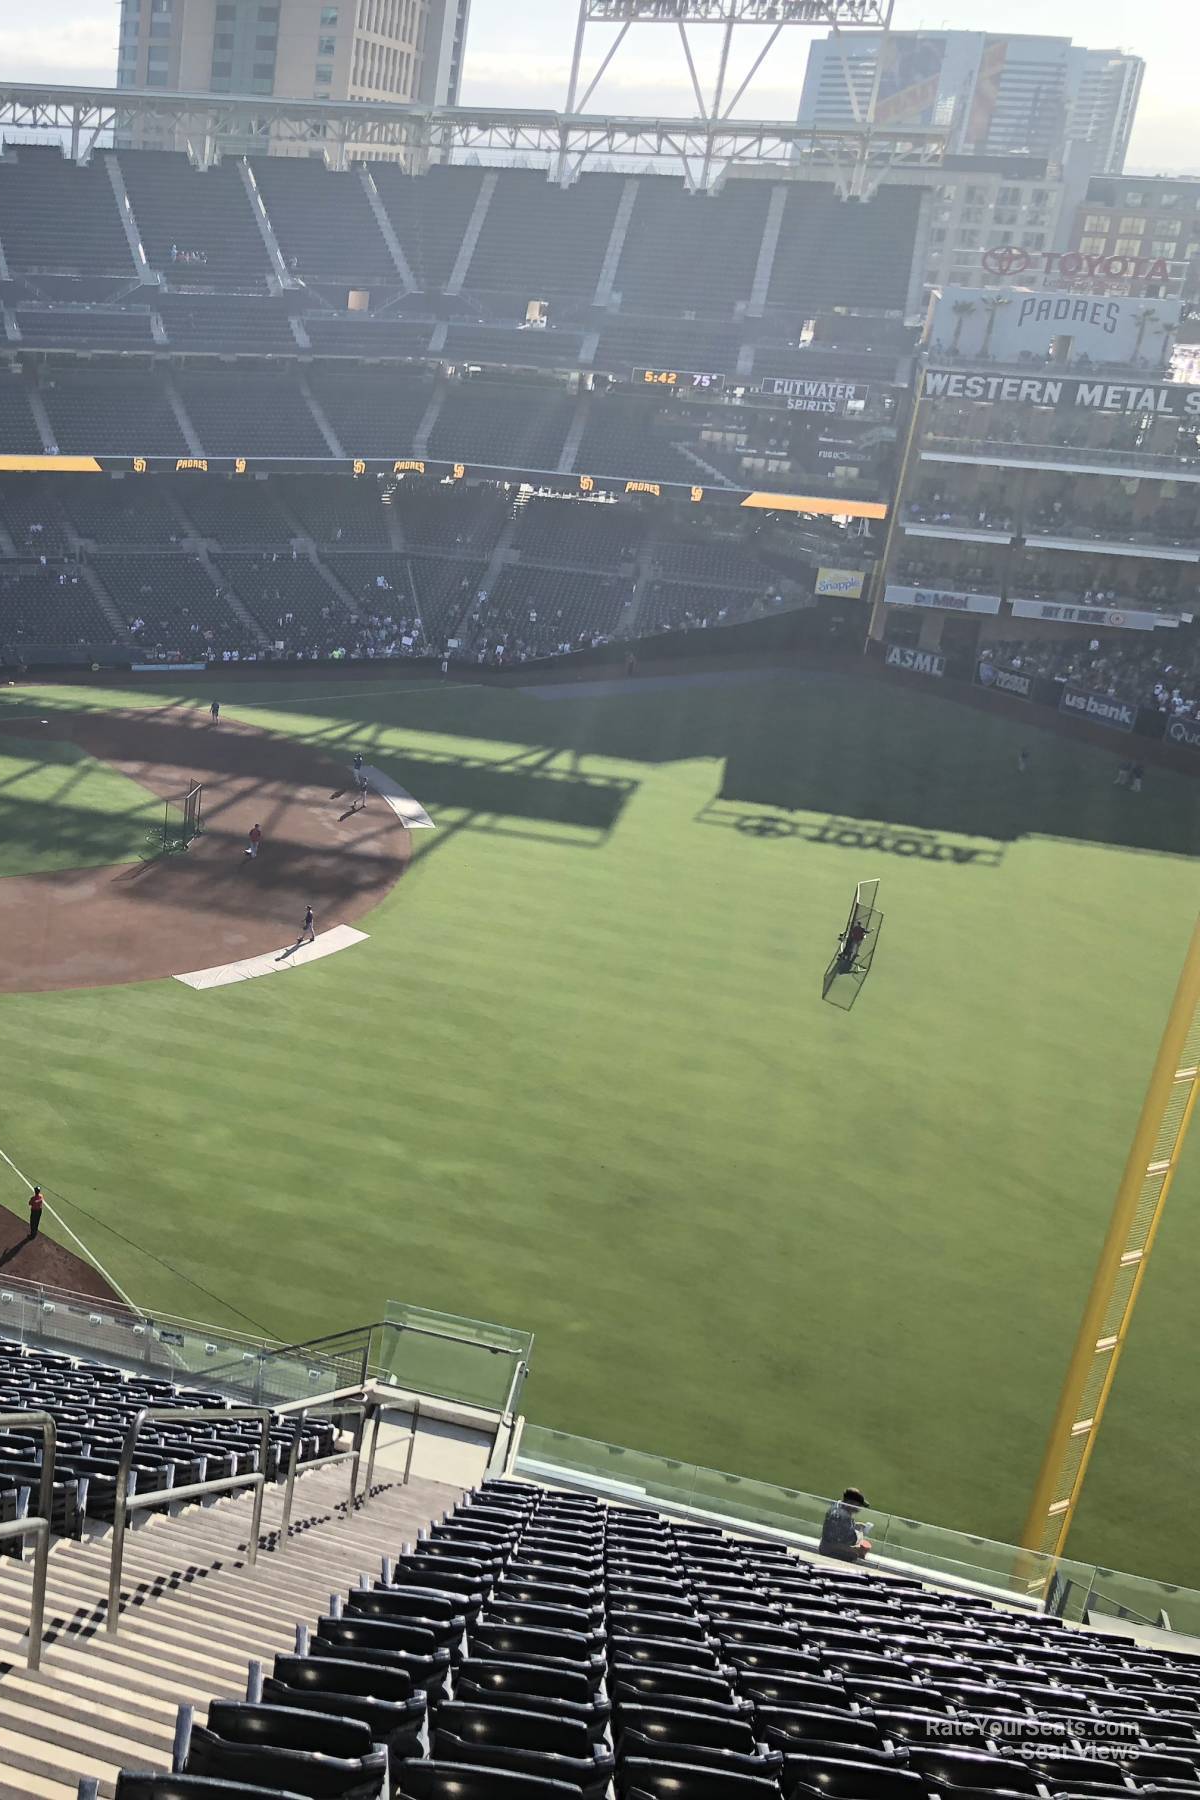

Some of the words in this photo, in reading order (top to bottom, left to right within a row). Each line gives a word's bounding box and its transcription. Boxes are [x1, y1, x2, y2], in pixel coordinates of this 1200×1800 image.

[1042, 251, 1169, 281] TOYOTA
[1018, 297, 1120, 334] PADRES
[644, 371, 677, 384] 5:42
[692, 374, 717, 388] 75°
[773, 380, 856, 400] CUTWATER
[926, 373, 1063, 404] WESTERN
[1075, 383, 1174, 412] METAL
[786, 398, 837, 413] SPIRITS
[175, 459, 208, 472] PADRES
[393, 460, 425, 474] PADRES
[624, 481, 660, 497] PADRES
[817, 577, 861, 593] Snapple
[887, 651, 944, 677] ASML
